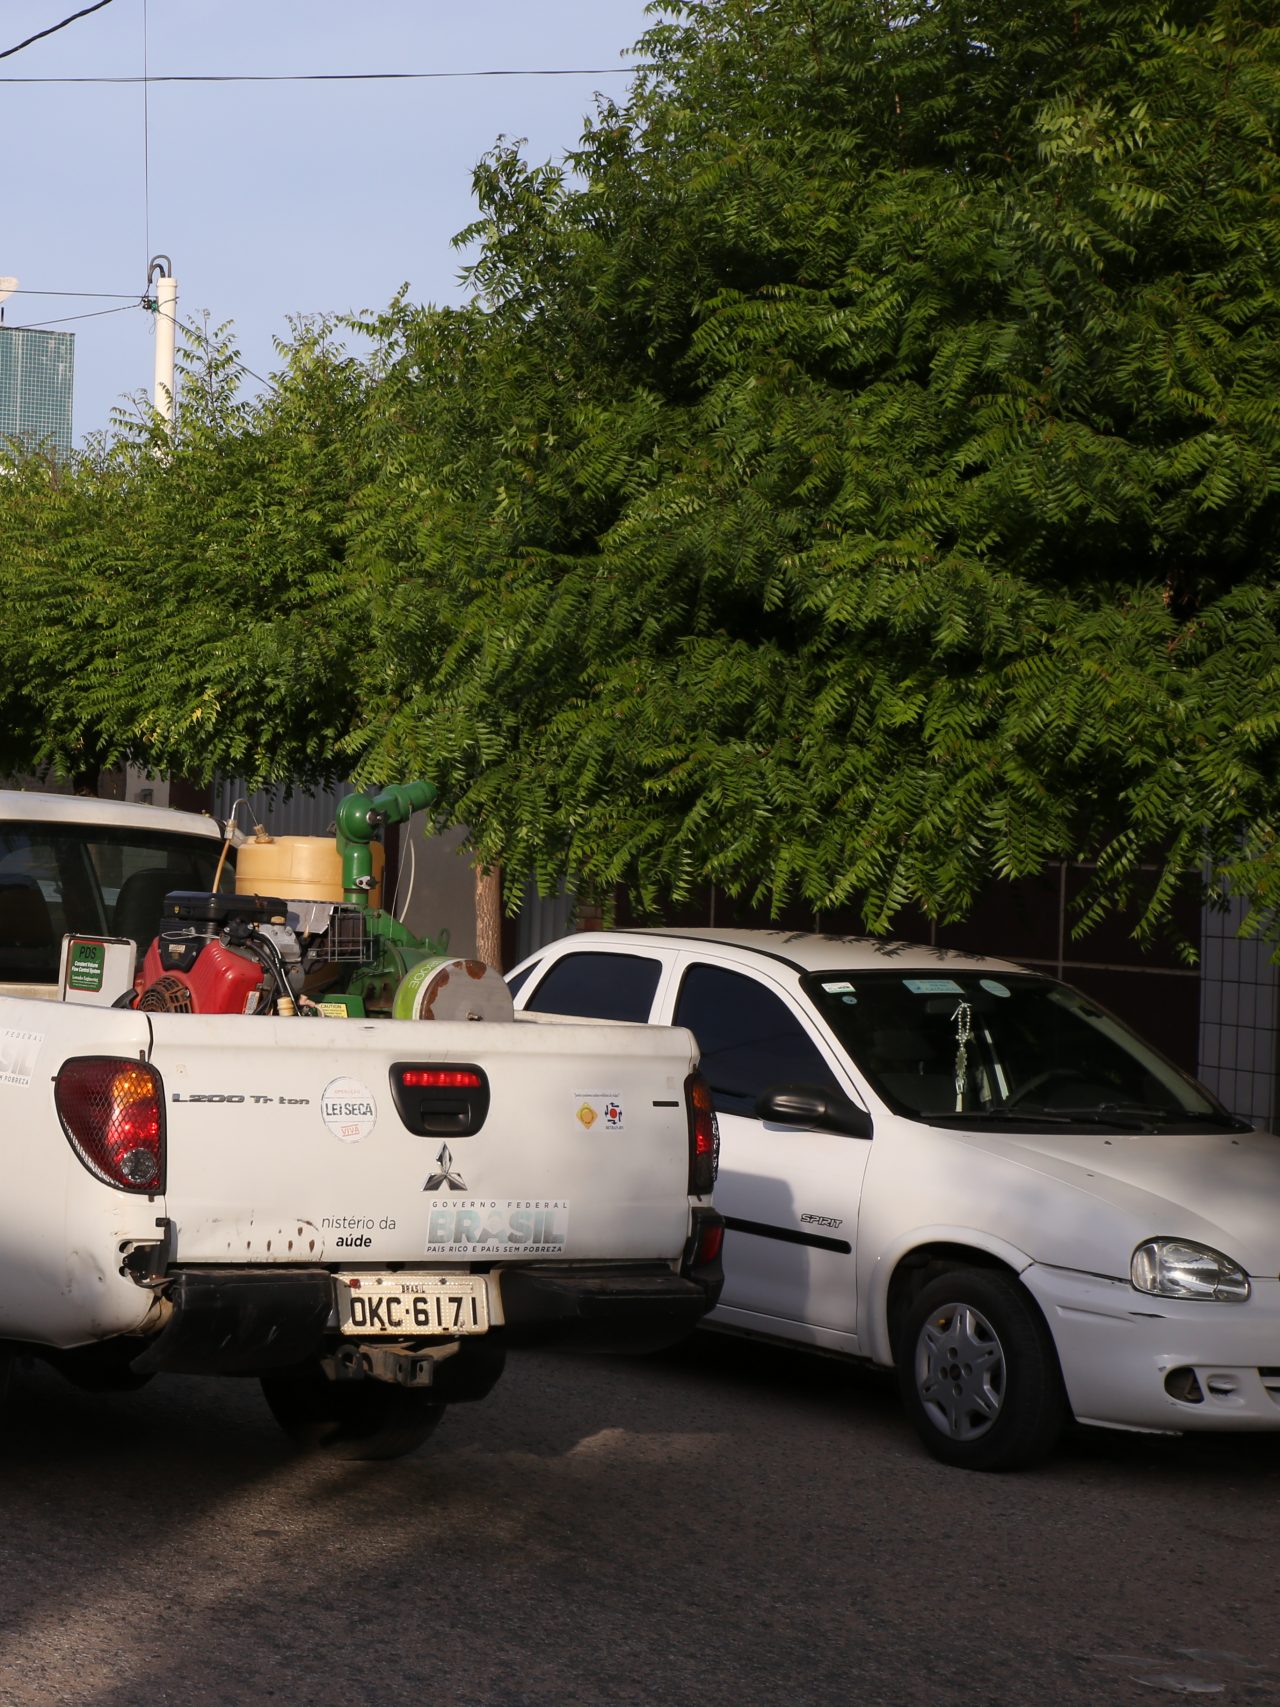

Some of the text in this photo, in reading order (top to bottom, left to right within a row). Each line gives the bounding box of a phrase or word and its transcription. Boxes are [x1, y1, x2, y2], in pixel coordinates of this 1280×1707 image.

[79, 946, 97, 959] PDS
[172, 1093, 246, 1104] L200
[344, 1102, 373, 1116] SECA
[507, 1201, 568, 1209] FEDERAL
[379, 1216, 396, 1230] da
[427, 1210, 565, 1244] BRASIL
[800, 1213, 843, 1229] SPIRIT
[426, 1245, 446, 1253] PAÍS
[449, 1245, 469, 1253] RICO
[481, 1245, 500, 1253] PAÍS
[523, 1245, 562, 1253] POBREZA
[401, 1284, 426, 1294] BRASIL
